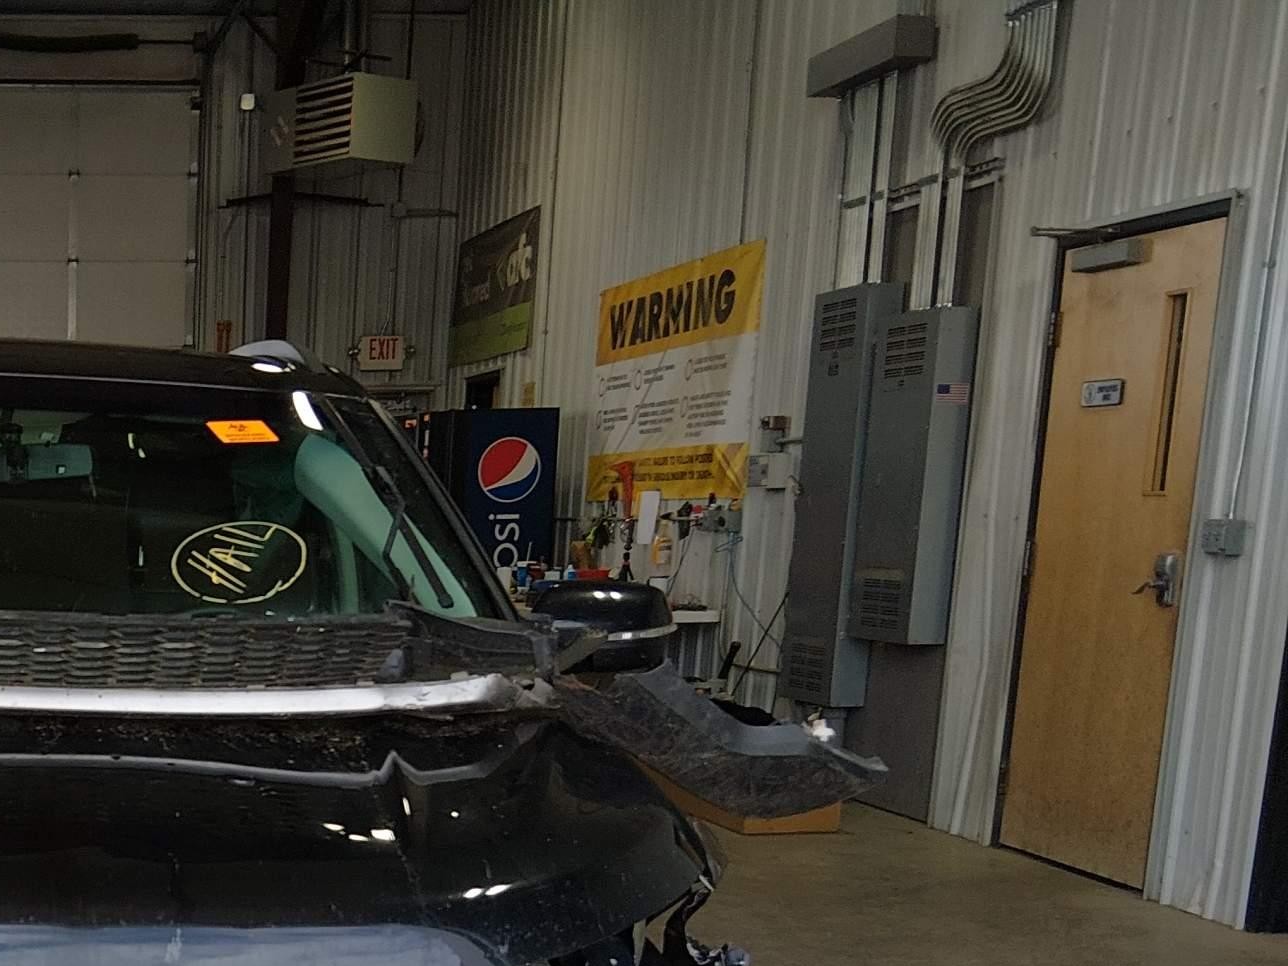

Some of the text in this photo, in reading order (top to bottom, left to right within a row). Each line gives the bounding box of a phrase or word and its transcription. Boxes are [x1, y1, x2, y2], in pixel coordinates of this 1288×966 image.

[610, 269, 736, 350] WARNING
[369, 337, 399, 360] EXIT
[187, 525, 277, 594] HAIL
